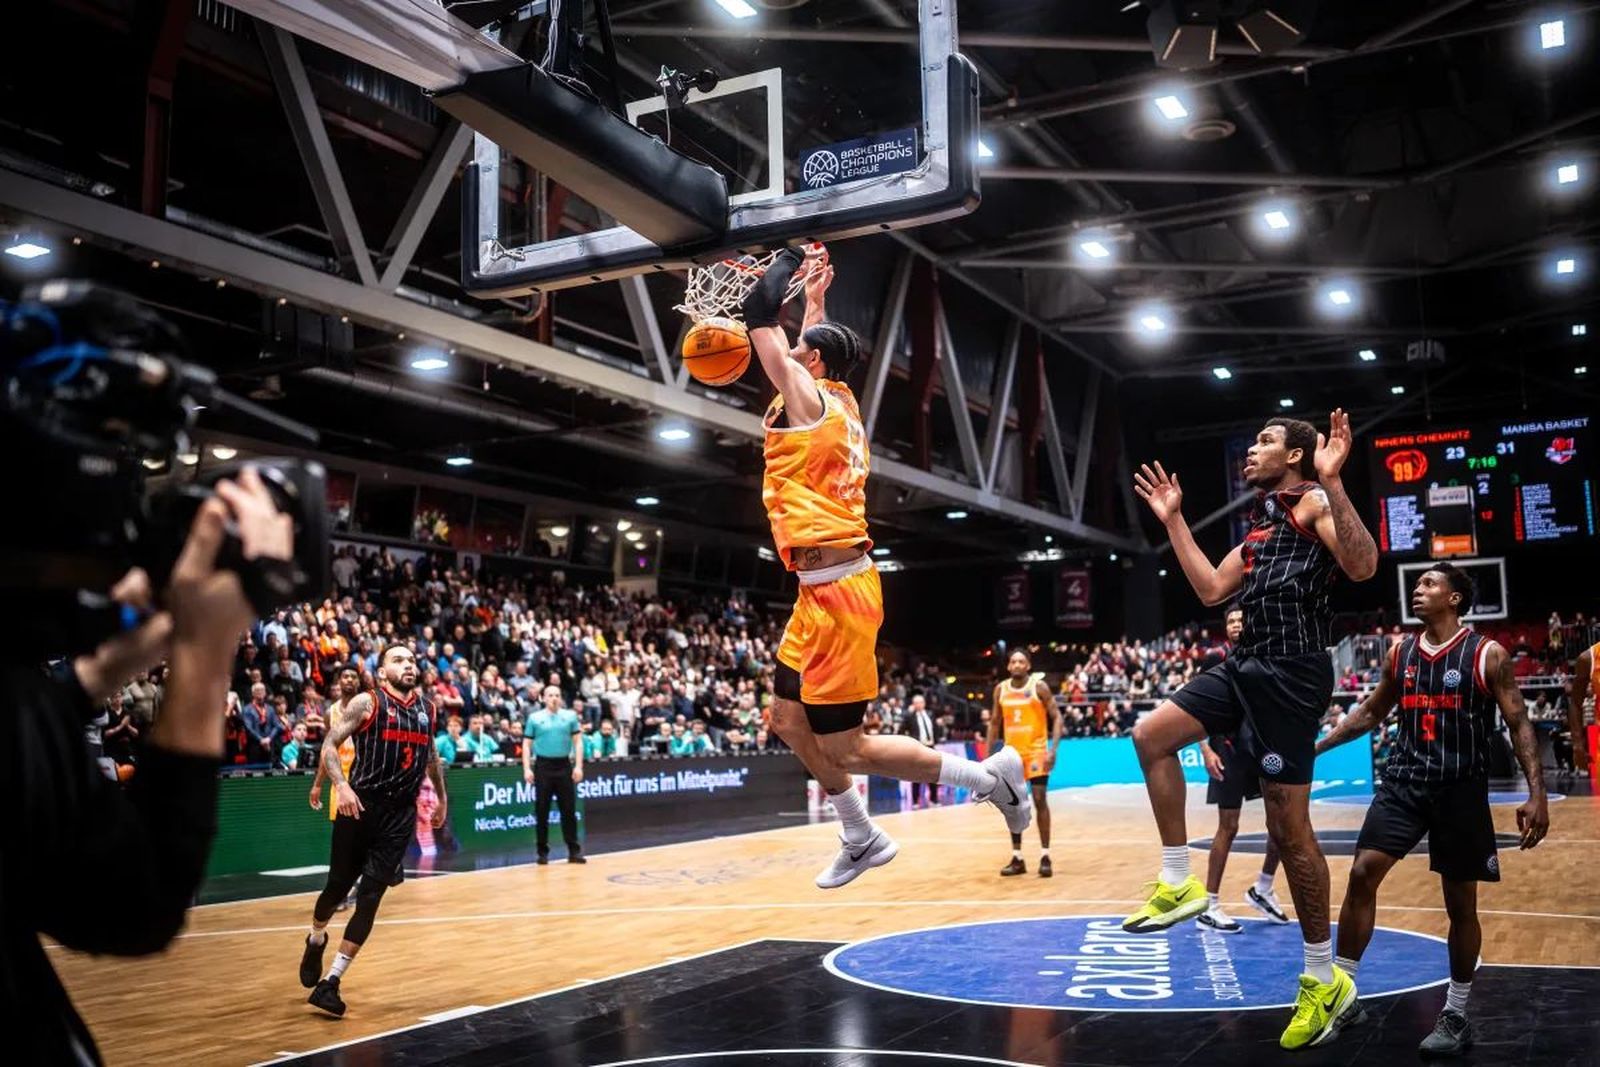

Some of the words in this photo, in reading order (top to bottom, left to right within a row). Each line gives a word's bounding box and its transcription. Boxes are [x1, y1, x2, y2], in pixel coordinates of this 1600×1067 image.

[840, 140, 904, 159] BASKETBALL
[841, 147, 913, 169] CHAMPIONS
[841, 164, 880, 179] LEAGUE
[1502, 423, 1544, 436] MANISA
[1545, 417, 1589, 431] BASKET
[1446, 446, 1465, 459] 23
[1496, 441, 1515, 455] 31
[1478, 482, 1489, 494] 2
[402, 747, 414, 769] 3
[577, 777, 612, 799] steht
[614, 774, 633, 797] für
[634, 777, 659, 793] uns
[660, 772, 676, 791] im
